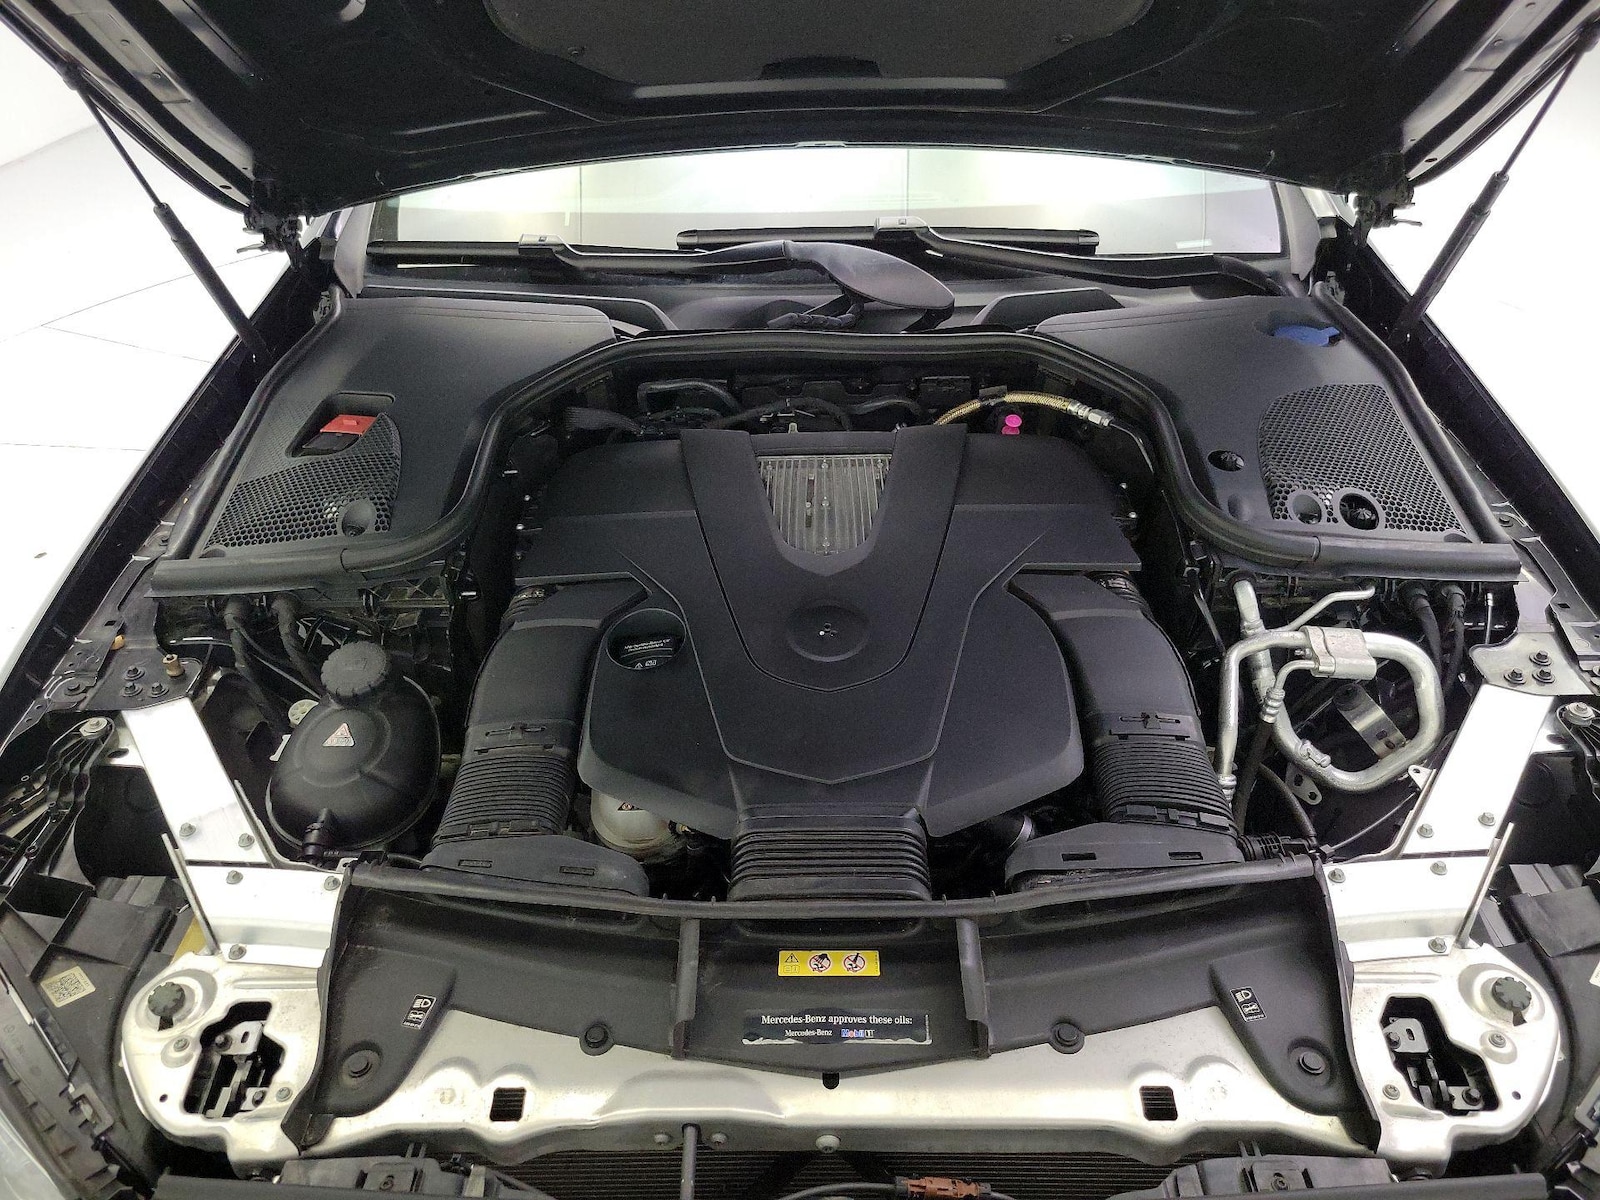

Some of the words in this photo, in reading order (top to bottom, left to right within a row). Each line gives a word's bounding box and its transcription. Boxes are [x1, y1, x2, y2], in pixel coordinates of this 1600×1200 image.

[761, 1015, 826, 1025] Mercedes-Benz
[828, 1015, 867, 1026] approves
[869, 1015, 892, 1024] these
[894, 1016, 912, 1025] oils:
[785, 1029, 833, 1037] Mercedes-Benz
